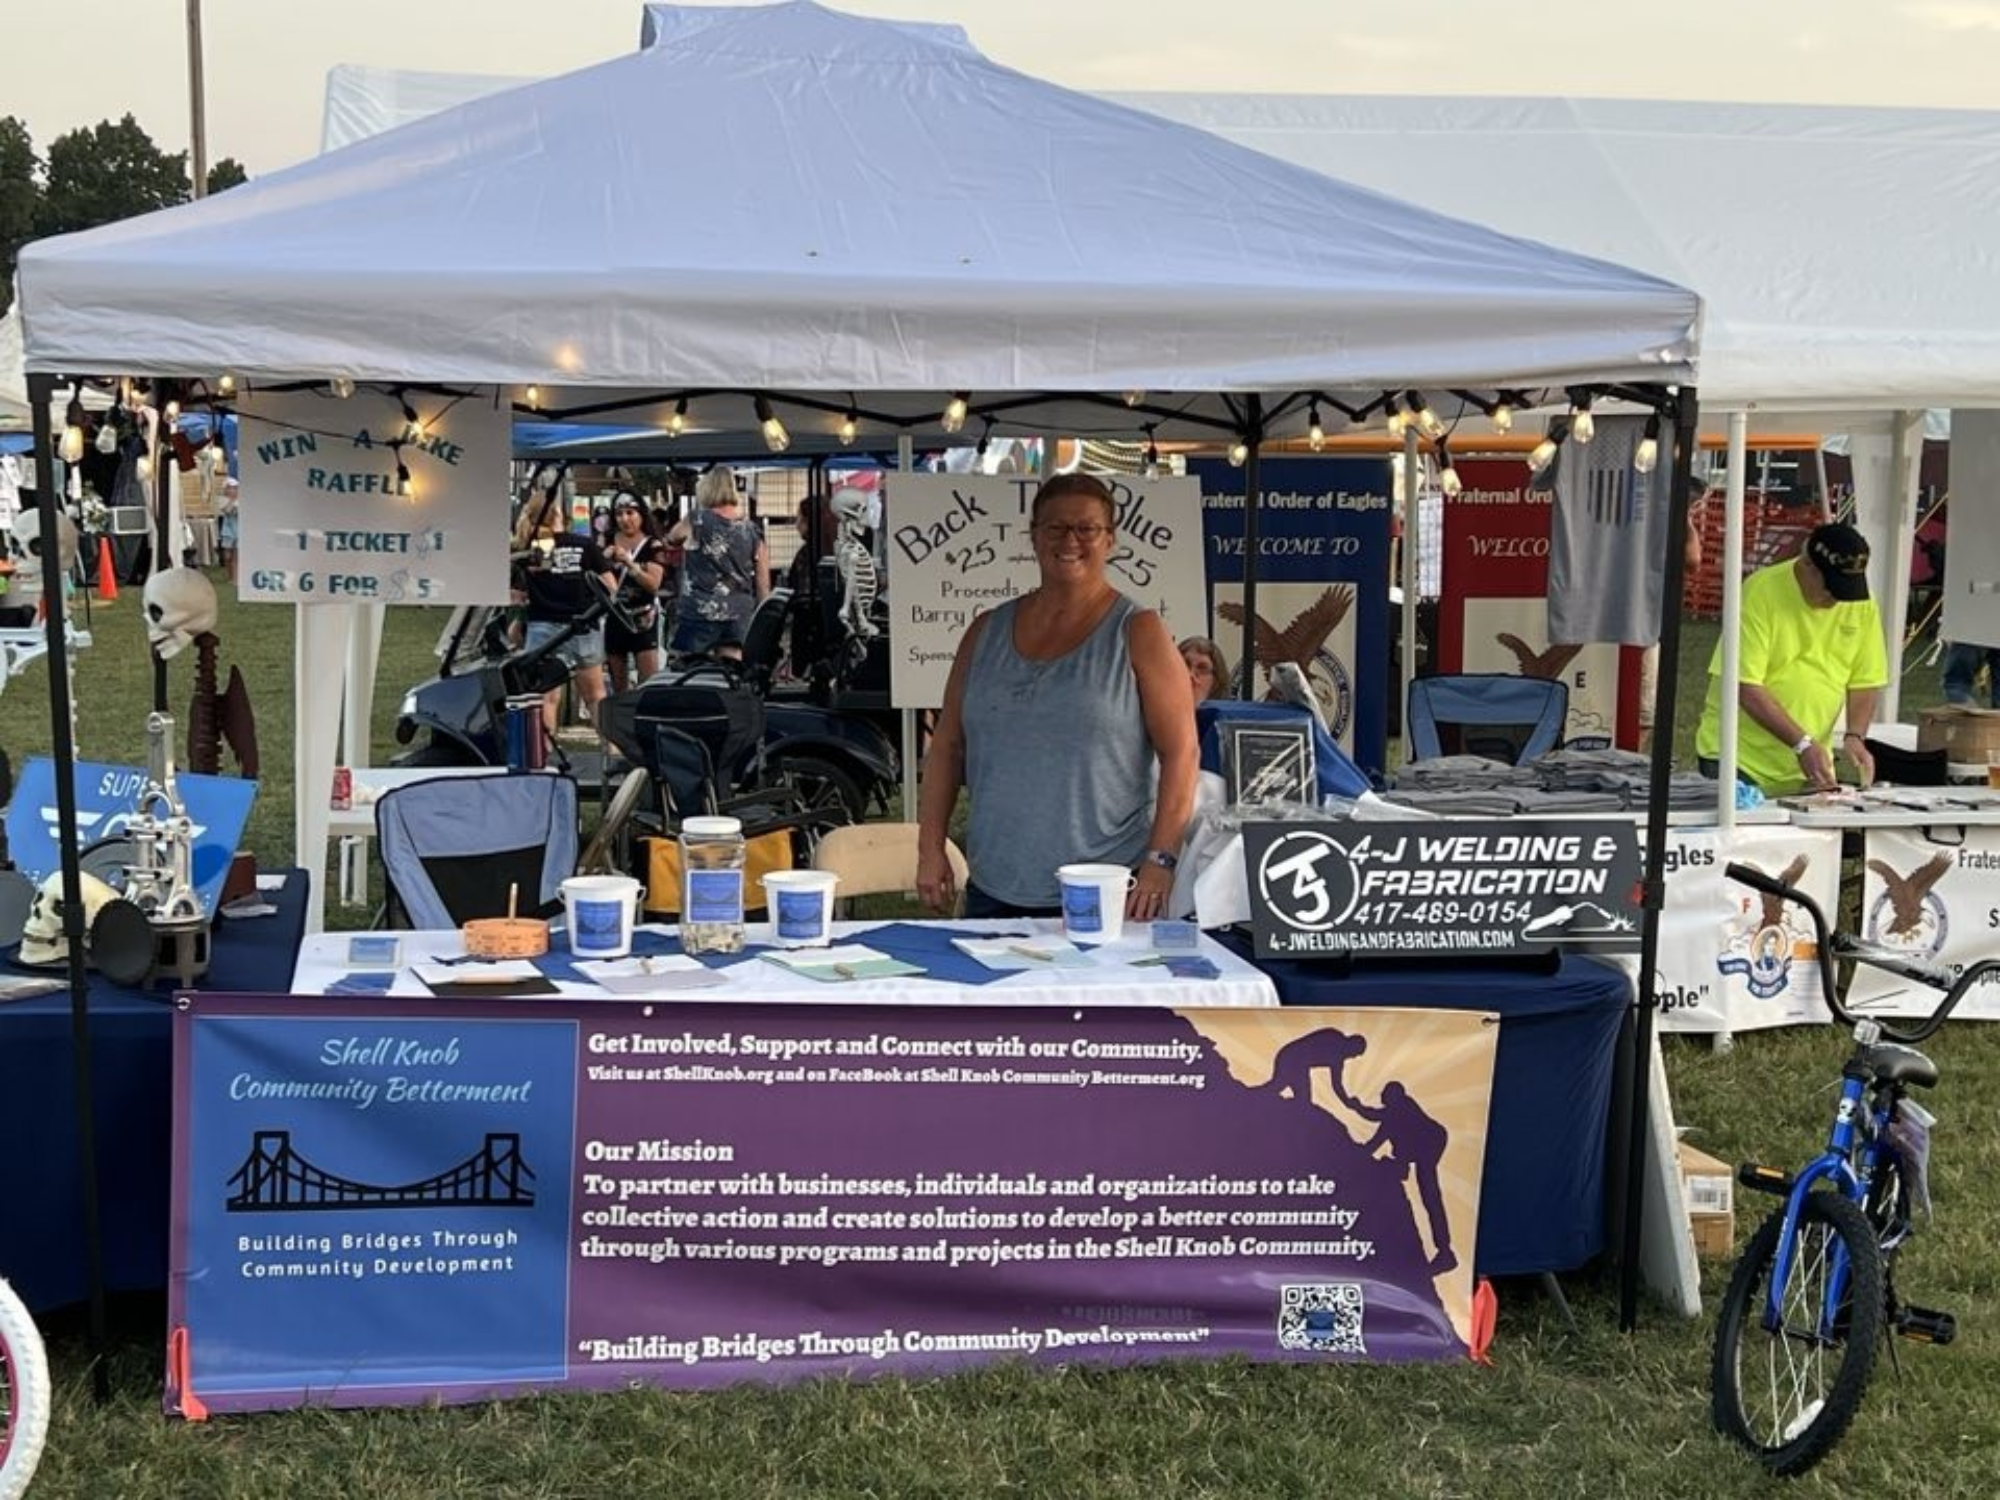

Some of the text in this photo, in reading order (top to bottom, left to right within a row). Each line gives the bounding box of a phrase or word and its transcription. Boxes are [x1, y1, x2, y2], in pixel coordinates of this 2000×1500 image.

[257, 433, 318, 465] WIN
[352, 429, 373, 449] A
[1268, 491, 1314, 509] Order
[1316, 491, 1332, 509] of
[1336, 491, 1388, 511] Eagles
[1523, 487, 1553, 504] Ord
[894, 489, 988, 565] Back
[324, 531, 411, 553] TICKET
[1213, 535, 1360, 555] WECOME TO
[1466, 534, 1551, 557] WELCO
[299, 571, 314, 593] 6
[328, 574, 379, 597] FOR
[941, 578, 1020, 598] Proceeds
[911, 604, 965, 633] Barry
[1418, 836, 1582, 863] WELDING
[1958, 850, 2000, 869] Frate
[1361, 868, 1609, 897] FABRICATION
[319, 1037, 460, 1067] Shell Knob
[588, 1032, 1204, 1062] Get Involved, Support and Connect with our Community.
[587, 1065, 1205, 1089] Visit us at ShellKnob.org and on FaceBook at Shell Knob Community Betterment.org
[230, 1073, 532, 1110] Community Betterment
[584, 1138, 734, 1162] Our Mission
[583, 1172, 1336, 1202] To partner with businesses, individuals and organizations to take
[582, 1204, 1360, 1232] collective action and create solutions to develop a better community
[238, 1230, 519, 1254] Building Bridges Through
[580, 1235, 1376, 1267] through various programs and projects in the Shell Knob Community.
[241, 1257, 515, 1279] Community Development
[701, 1332, 797, 1361] Bridges
[798, 1328, 901, 1357] Through
[903, 1326, 1043, 1355] Community
